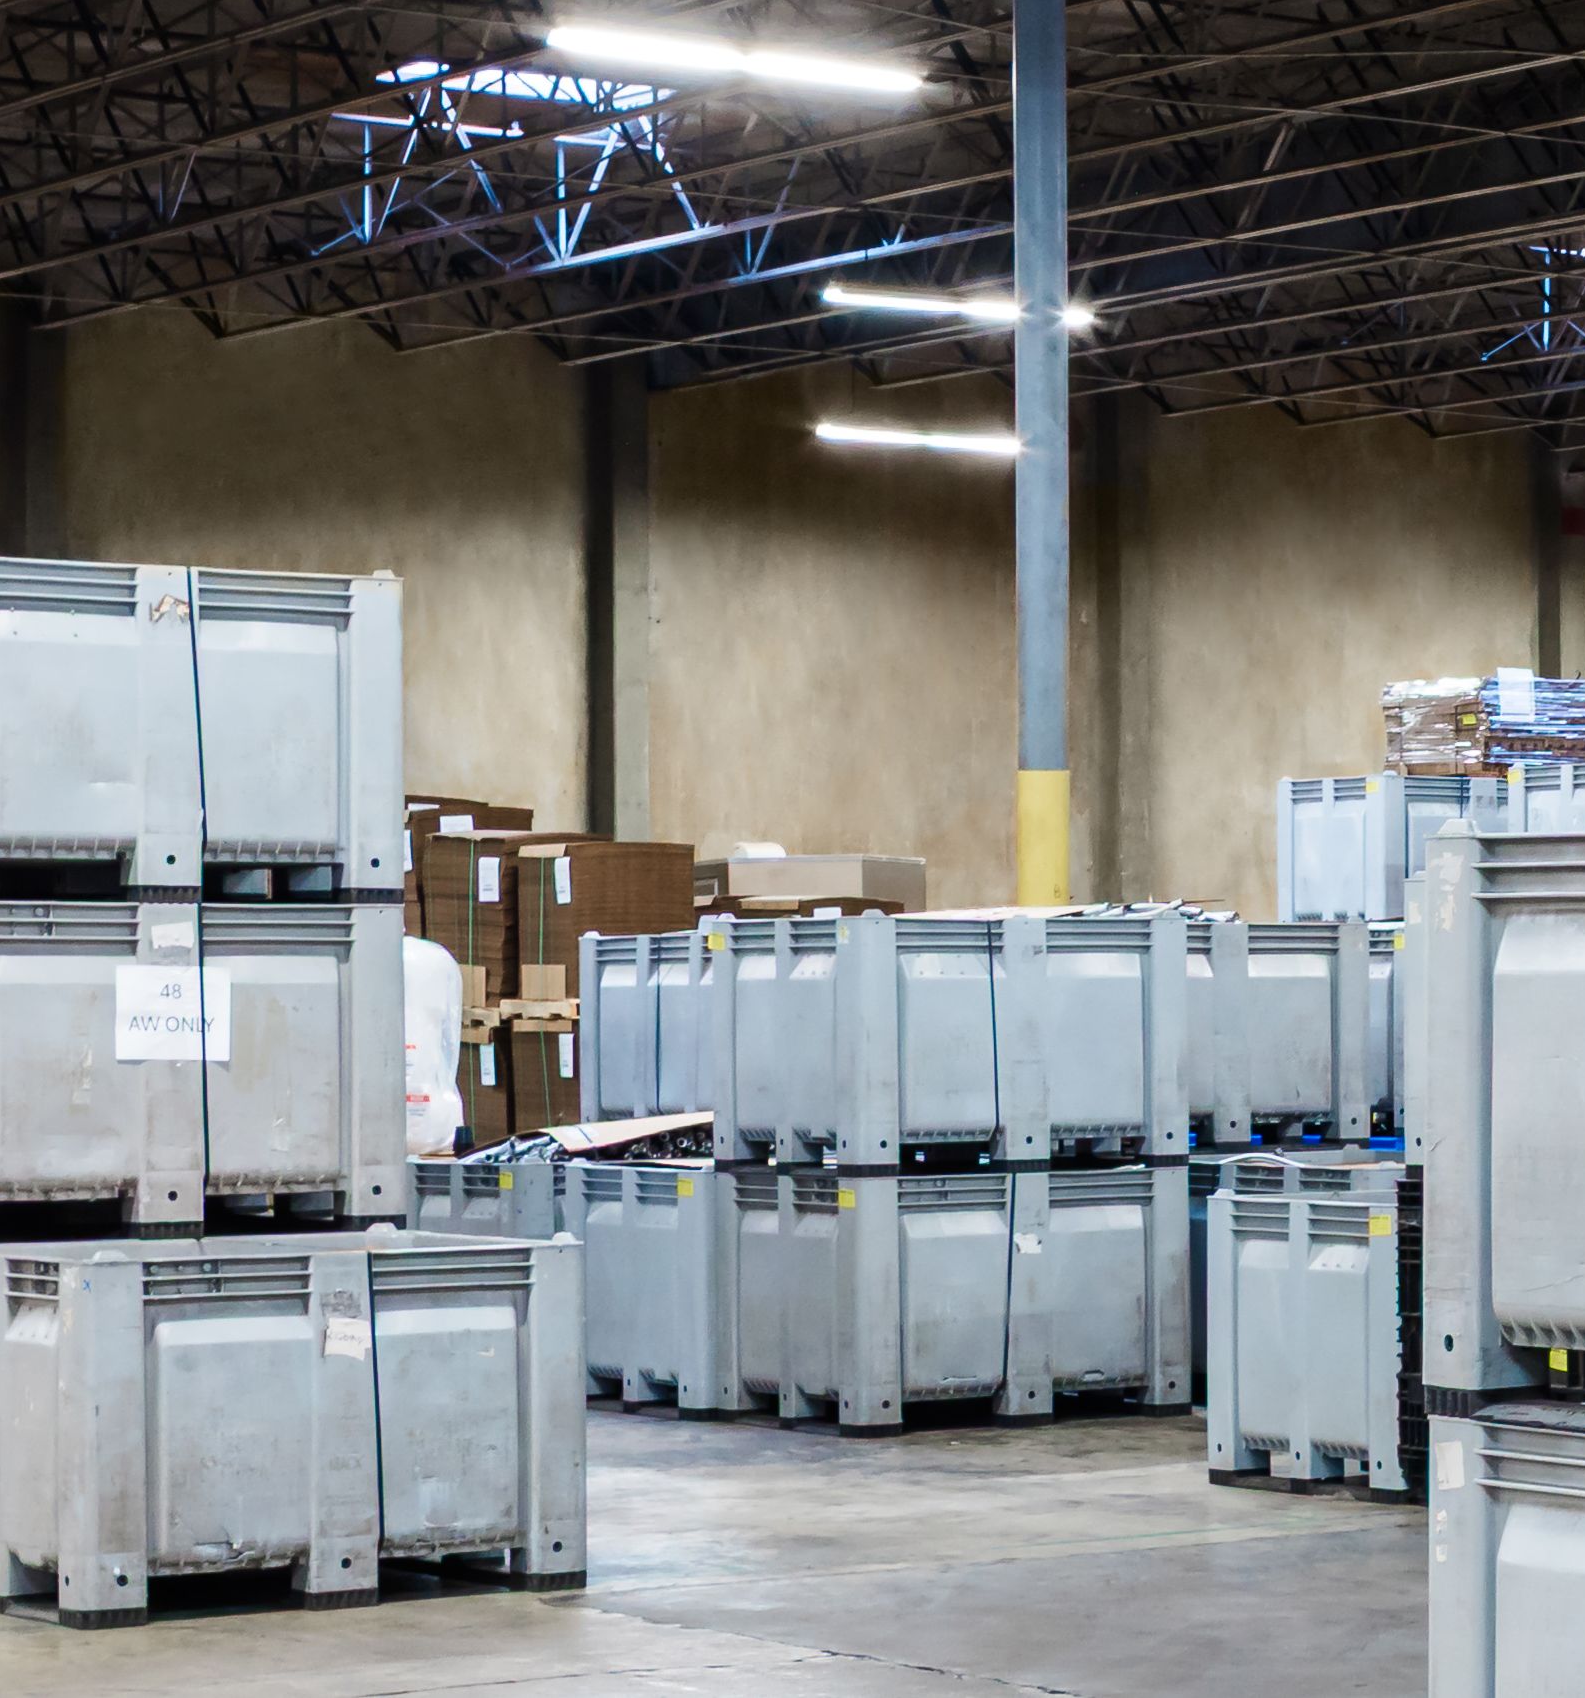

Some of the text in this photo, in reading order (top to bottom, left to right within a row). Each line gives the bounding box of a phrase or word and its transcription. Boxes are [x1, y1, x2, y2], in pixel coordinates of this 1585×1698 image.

[160, 983, 182, 999] 48
[129, 1016, 215, 1033] AW ONLY
